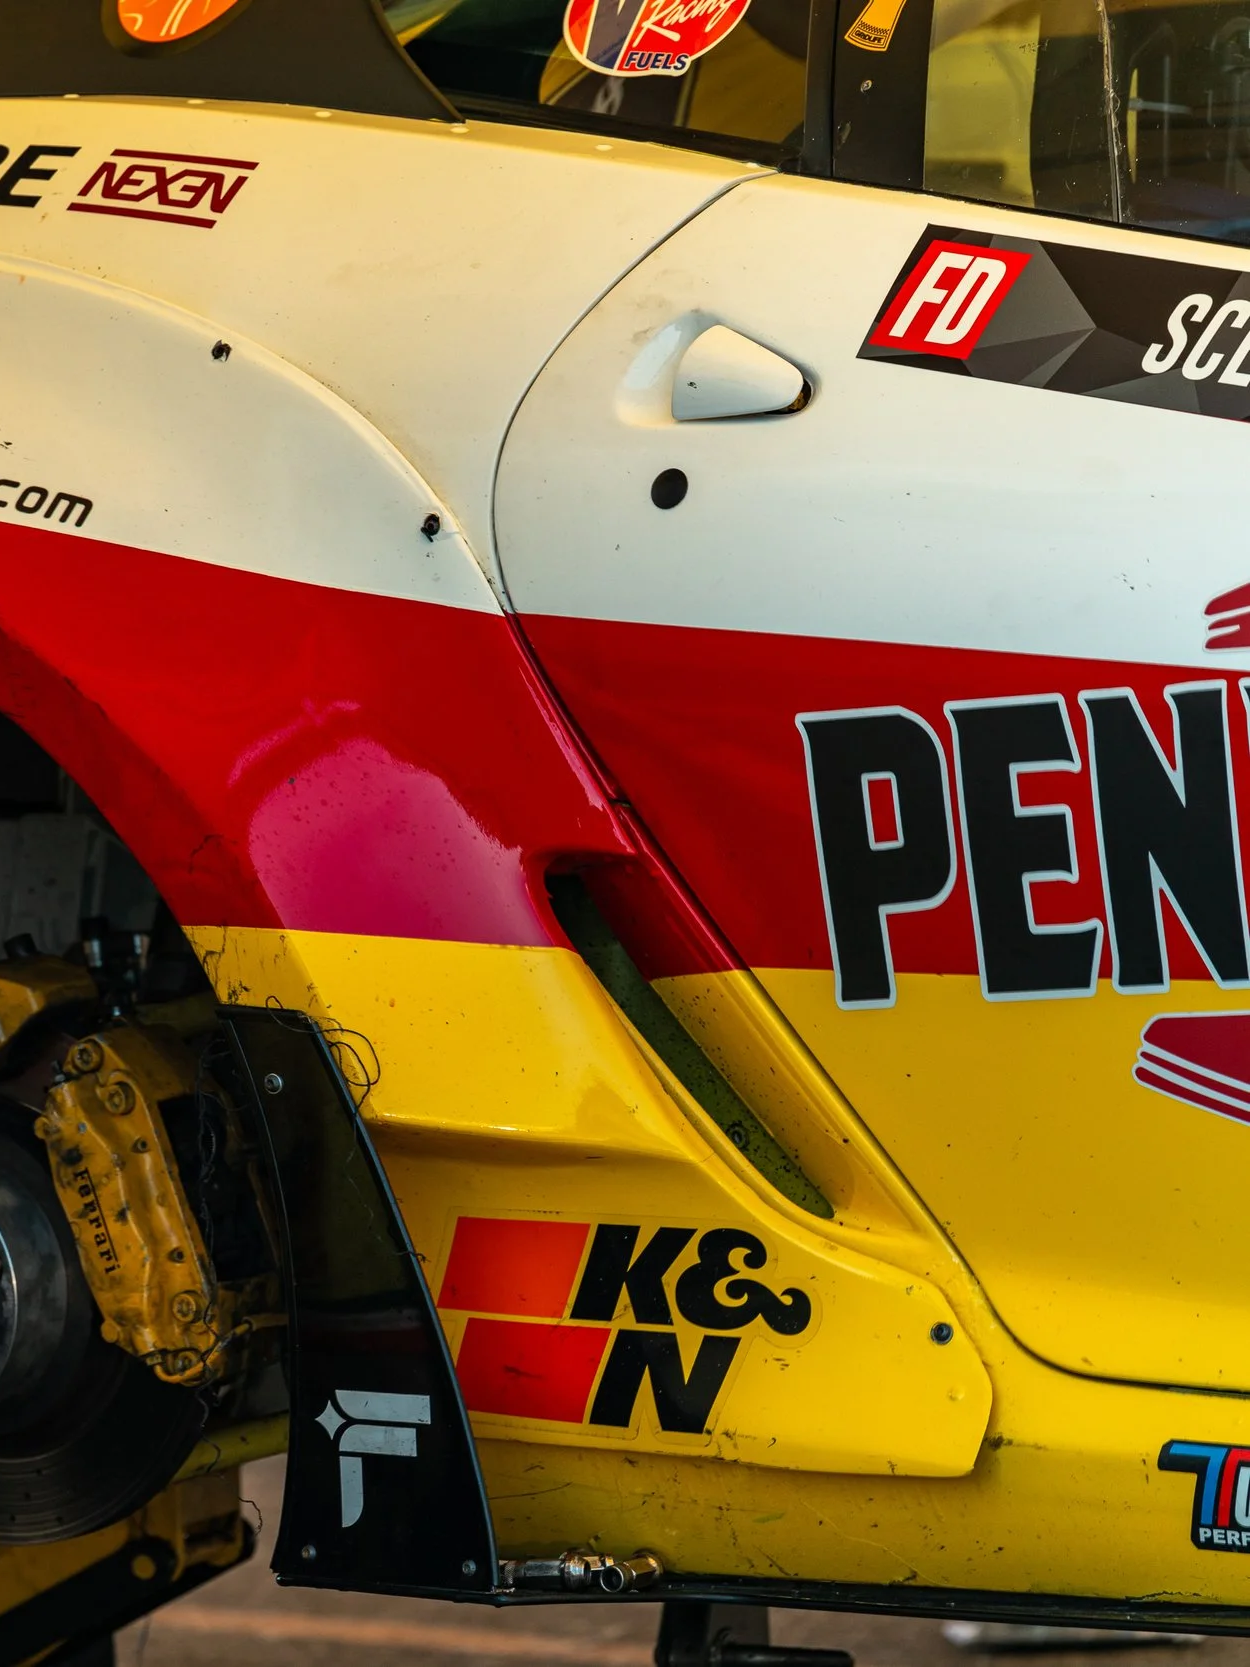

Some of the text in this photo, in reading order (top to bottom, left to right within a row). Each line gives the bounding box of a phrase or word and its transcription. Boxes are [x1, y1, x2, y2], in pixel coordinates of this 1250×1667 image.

[624, 51, 690, 71] FUELS
[77, 161, 249, 214] NEXEN
[888, 251, 1007, 345] FD
[795, 678, 1250, 1010] PEN
[72, 1167, 121, 1275] Ferrari
[569, 1223, 811, 1336] K&
[589, 1328, 742, 1434] N
